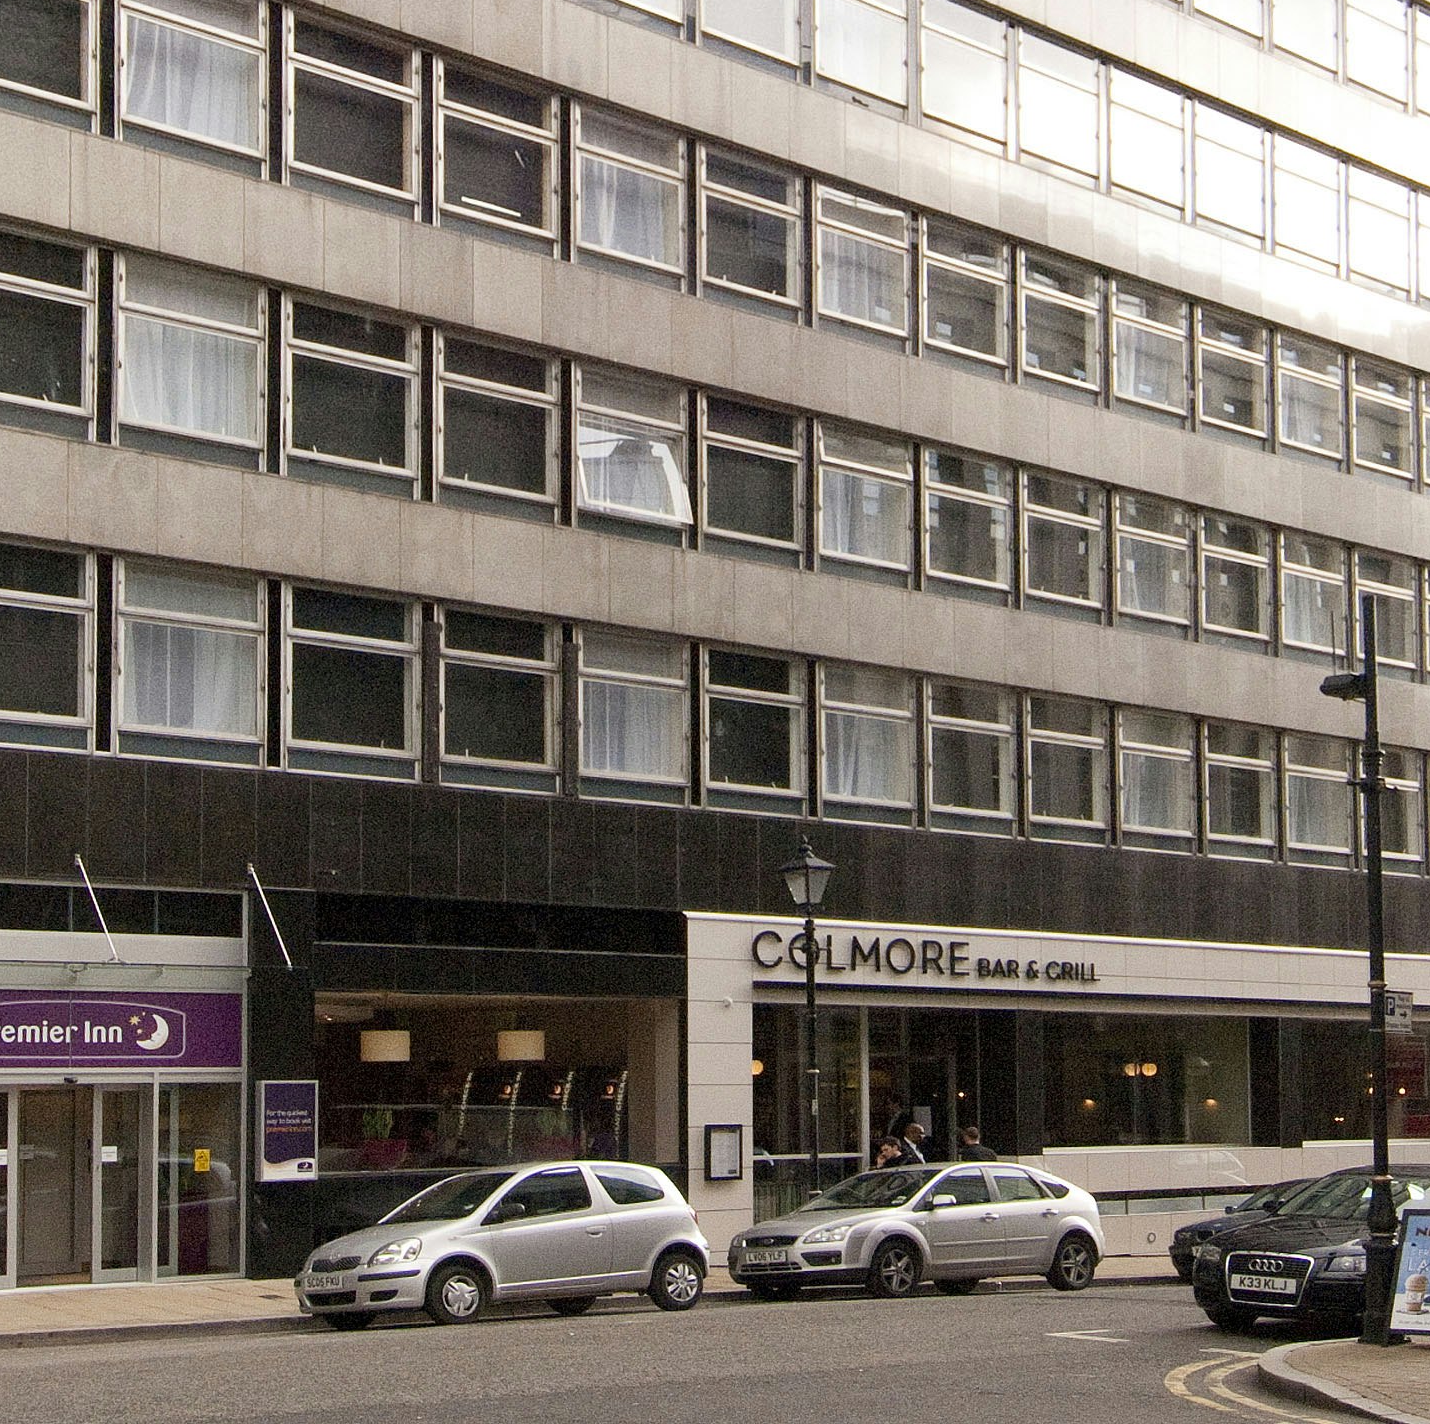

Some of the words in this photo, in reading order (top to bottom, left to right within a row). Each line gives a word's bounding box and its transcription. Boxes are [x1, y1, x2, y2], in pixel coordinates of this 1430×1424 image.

[752, 930, 971, 977] COLMORE
[977, 957, 1021, 979] BAR
[1026, 959, 1040, 979] &
[1045, 960, 1101, 982] GRILL
[84, 1020, 123, 1044] Inn
[1238, 1276, 1262, 1289] K33
[1263, 1278, 1287, 1291] KLJ
